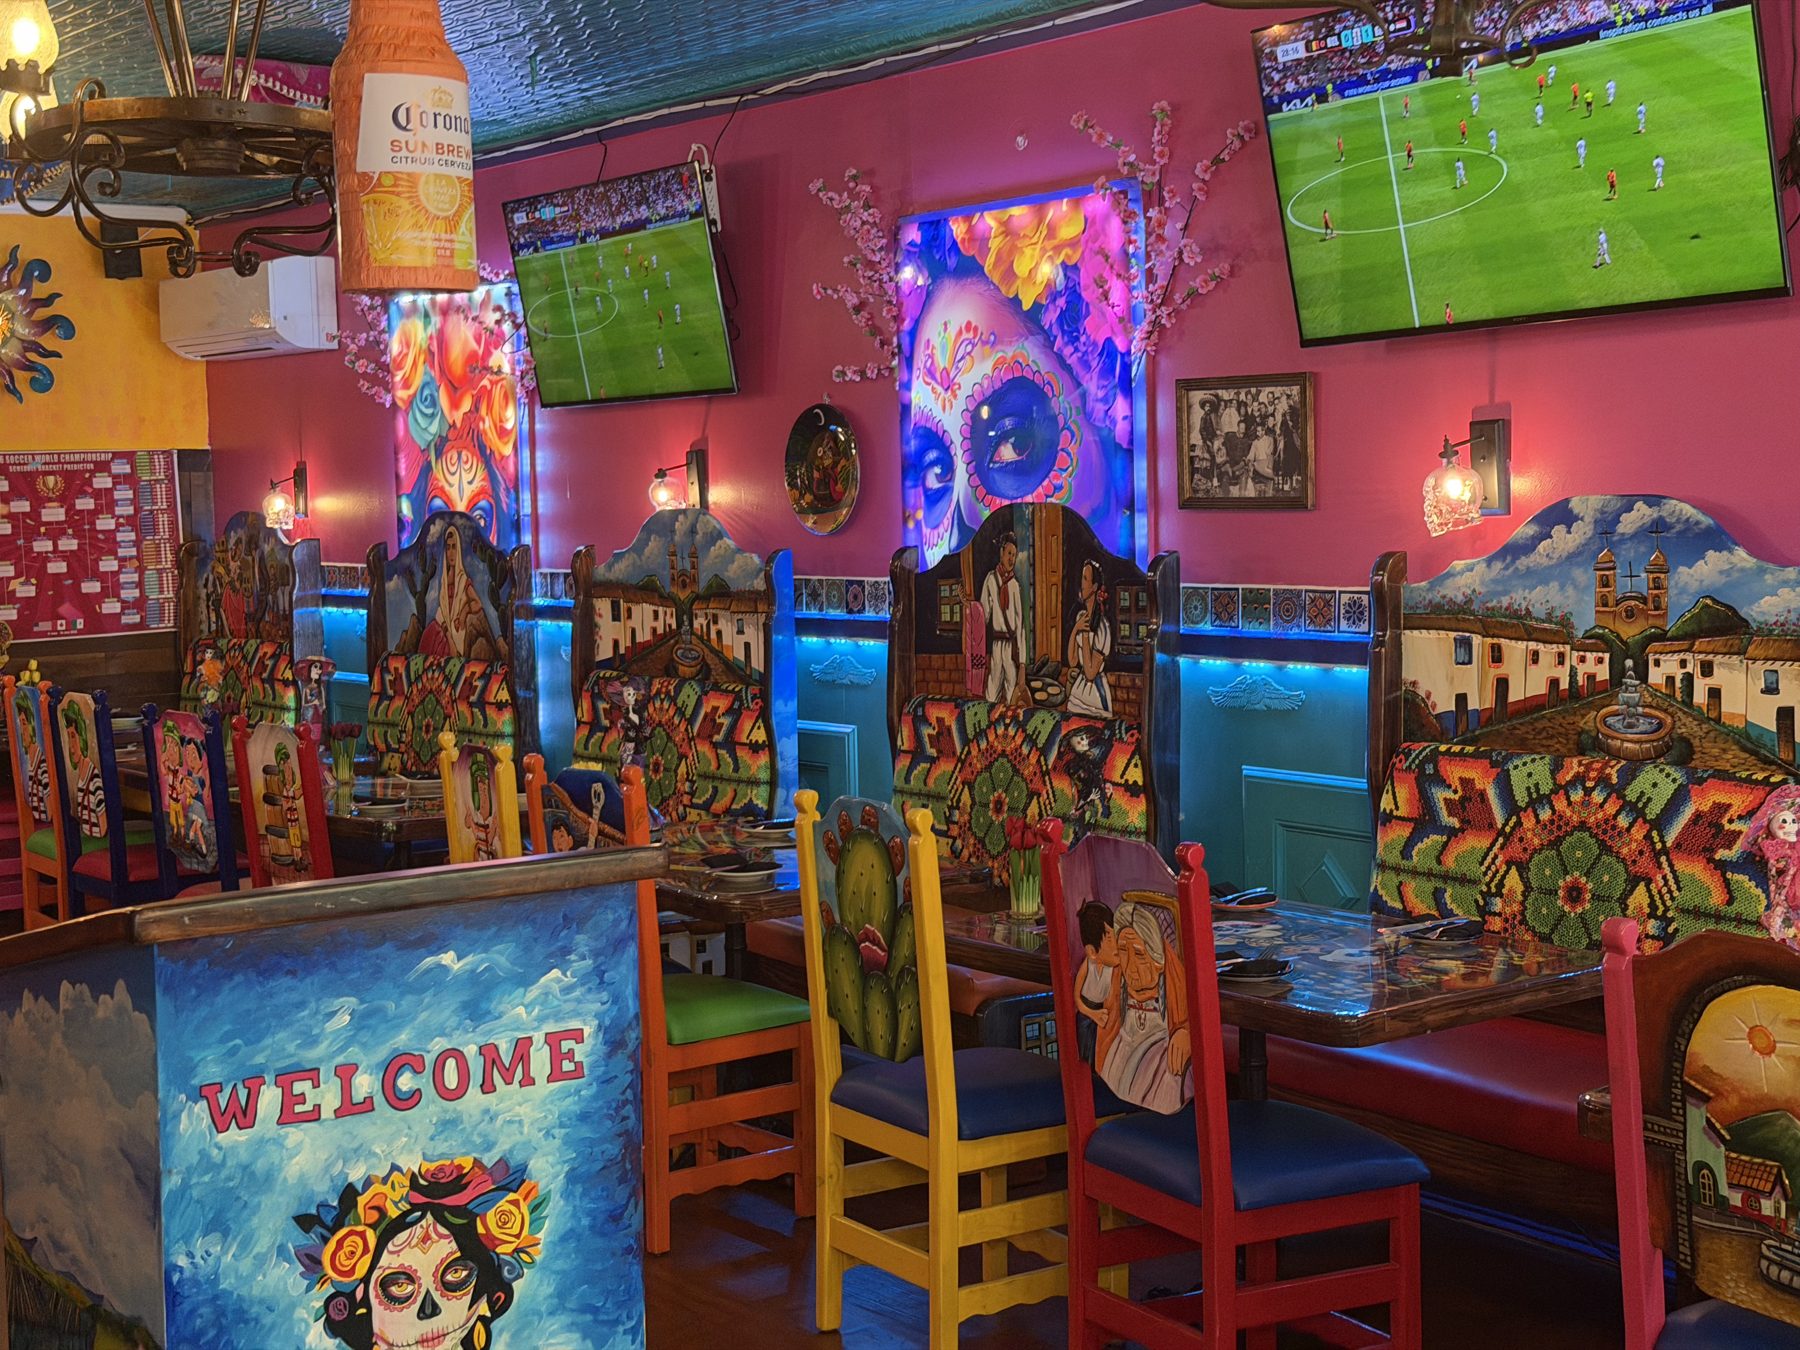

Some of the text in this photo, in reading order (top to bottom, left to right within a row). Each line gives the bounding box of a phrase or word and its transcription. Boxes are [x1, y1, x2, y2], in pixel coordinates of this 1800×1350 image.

[1599, 3, 1713, 39] Inspiration connects us all
[391, 101, 470, 136] Corona
[390, 155, 435, 166] CITRUS
[6, 455, 33, 464] SOCCER
[35, 454, 58, 463] WORLD
[60, 453, 112, 462] CHAMPIONSHIP
[63, 463, 94, 471] PREDICTOR
[200, 1028, 586, 1134] WELCOME
